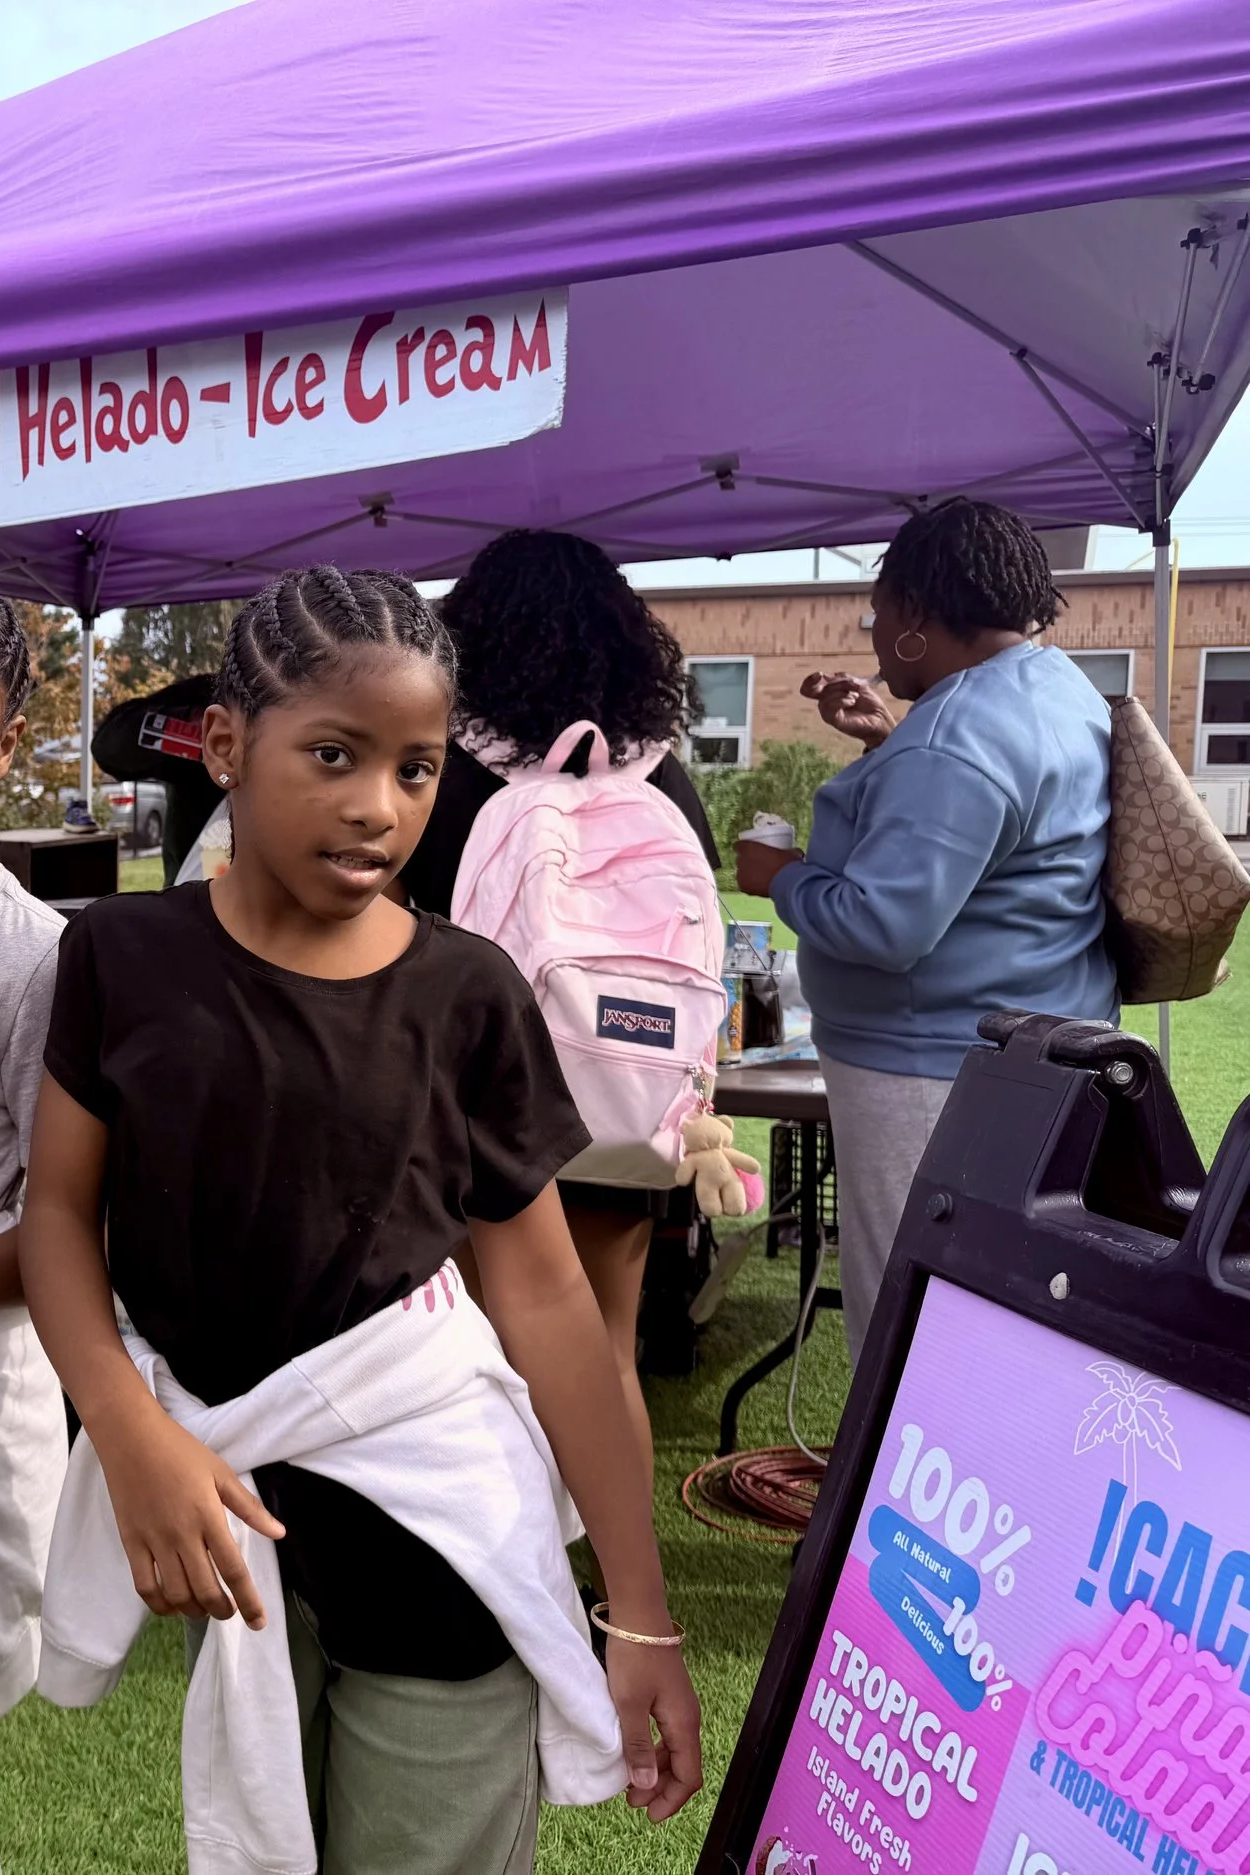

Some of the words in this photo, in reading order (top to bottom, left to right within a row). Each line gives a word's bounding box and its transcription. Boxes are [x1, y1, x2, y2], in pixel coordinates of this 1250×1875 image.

[14, 346, 190, 482] Helado
[244, 331, 326, 438] Ice
[888, 1423, 1033, 1597] 100%
[909, 1542, 953, 1584] Natural
[900, 1595, 945, 1656] Delicious
[1074, 1478, 1250, 1697] !CAC
[829, 1629, 979, 1803] TROPICAL
[942, 1596, 1013, 1711] 100%
[806, 1745, 860, 1814] Island
[858, 1799, 912, 1872] Fresh
[808, 1677, 933, 1820] HELADO
[1029, 1739, 1048, 1777] &
[1049, 1748, 1150, 1864] TROPICAL
[816, 1790, 882, 1875] Flavors
